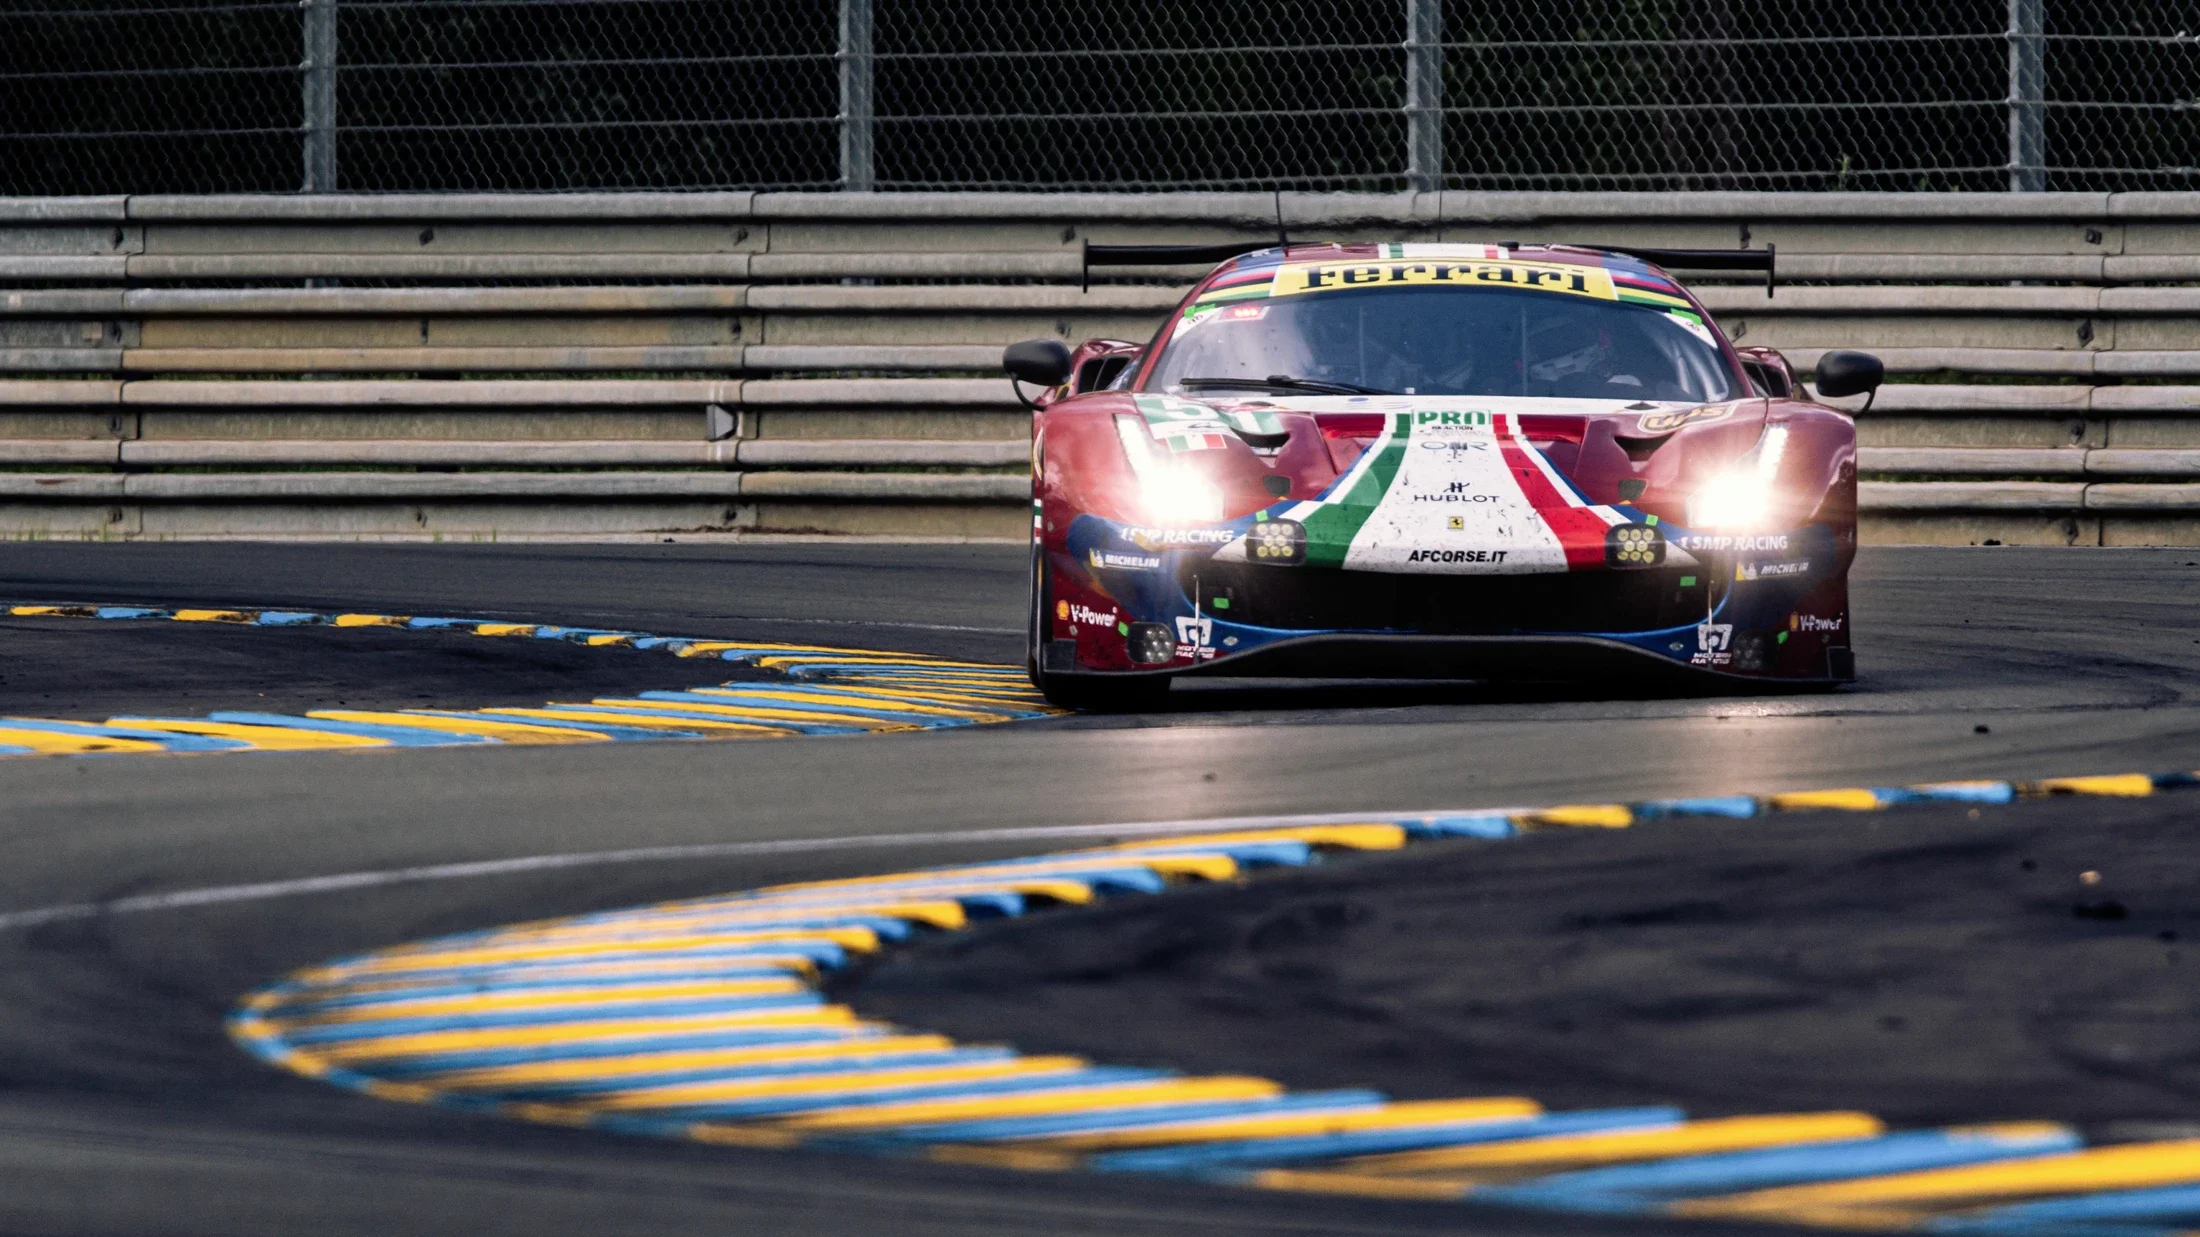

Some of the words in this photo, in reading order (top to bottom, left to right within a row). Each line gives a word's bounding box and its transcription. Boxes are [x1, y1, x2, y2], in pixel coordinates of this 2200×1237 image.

[1299, 264, 1590, 293] Ferrari
[1418, 411, 1486, 425] PRO
[1414, 494, 1500, 503] HUBLOT
[1163, 529, 1235, 543] RACING
[1691, 535, 1732, 550] SMP
[1733, 535, 1788, 550] RACING
[1105, 554, 1160, 568] MICHELIN
[1408, 550, 1508, 563] AFCORSE.IT
[1761, 562, 1809, 575] MICHELIN
[1070, 604, 1117, 627] V-Power
[1800, 613, 1842, 632] V-Power
